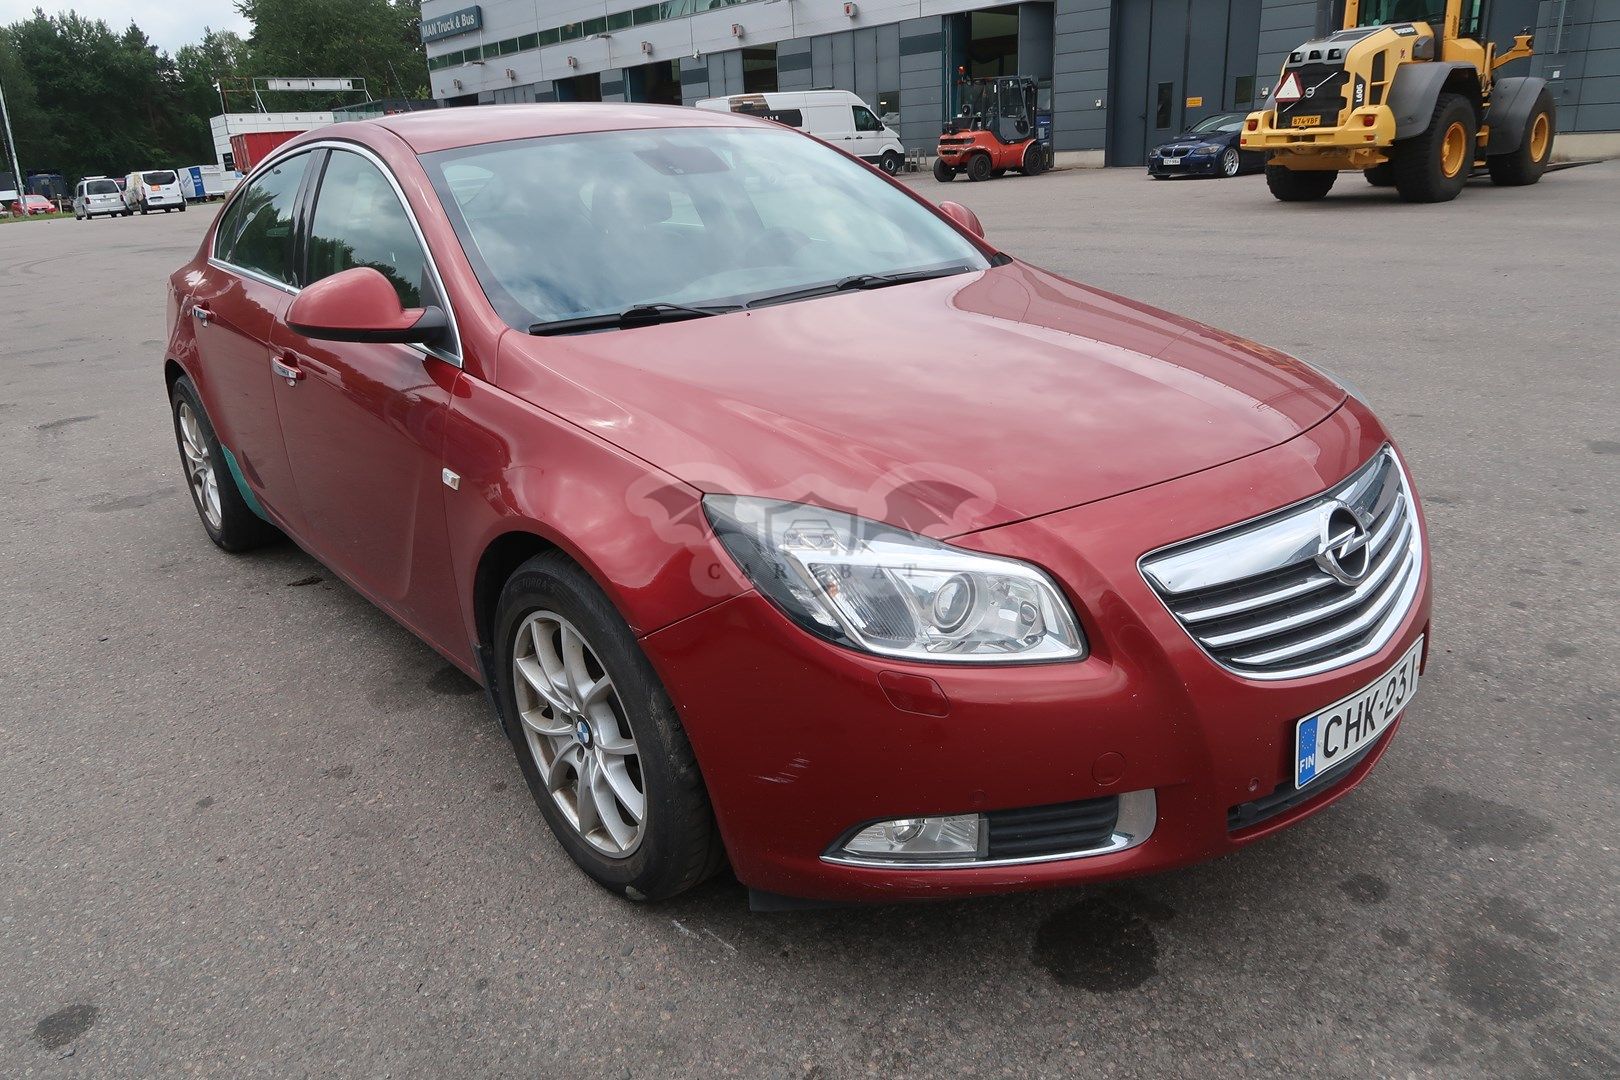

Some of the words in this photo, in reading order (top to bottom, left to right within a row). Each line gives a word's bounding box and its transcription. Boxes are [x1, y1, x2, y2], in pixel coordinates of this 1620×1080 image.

[422, 22, 437, 38] MAN
[437, 18, 455, 33] Truck
[455, 15, 461, 28] &
[461, 14, 475, 27] Bus
[1323, 653, 1416, 759] CHK-231
[1299, 753, 1315, 774] FIN
